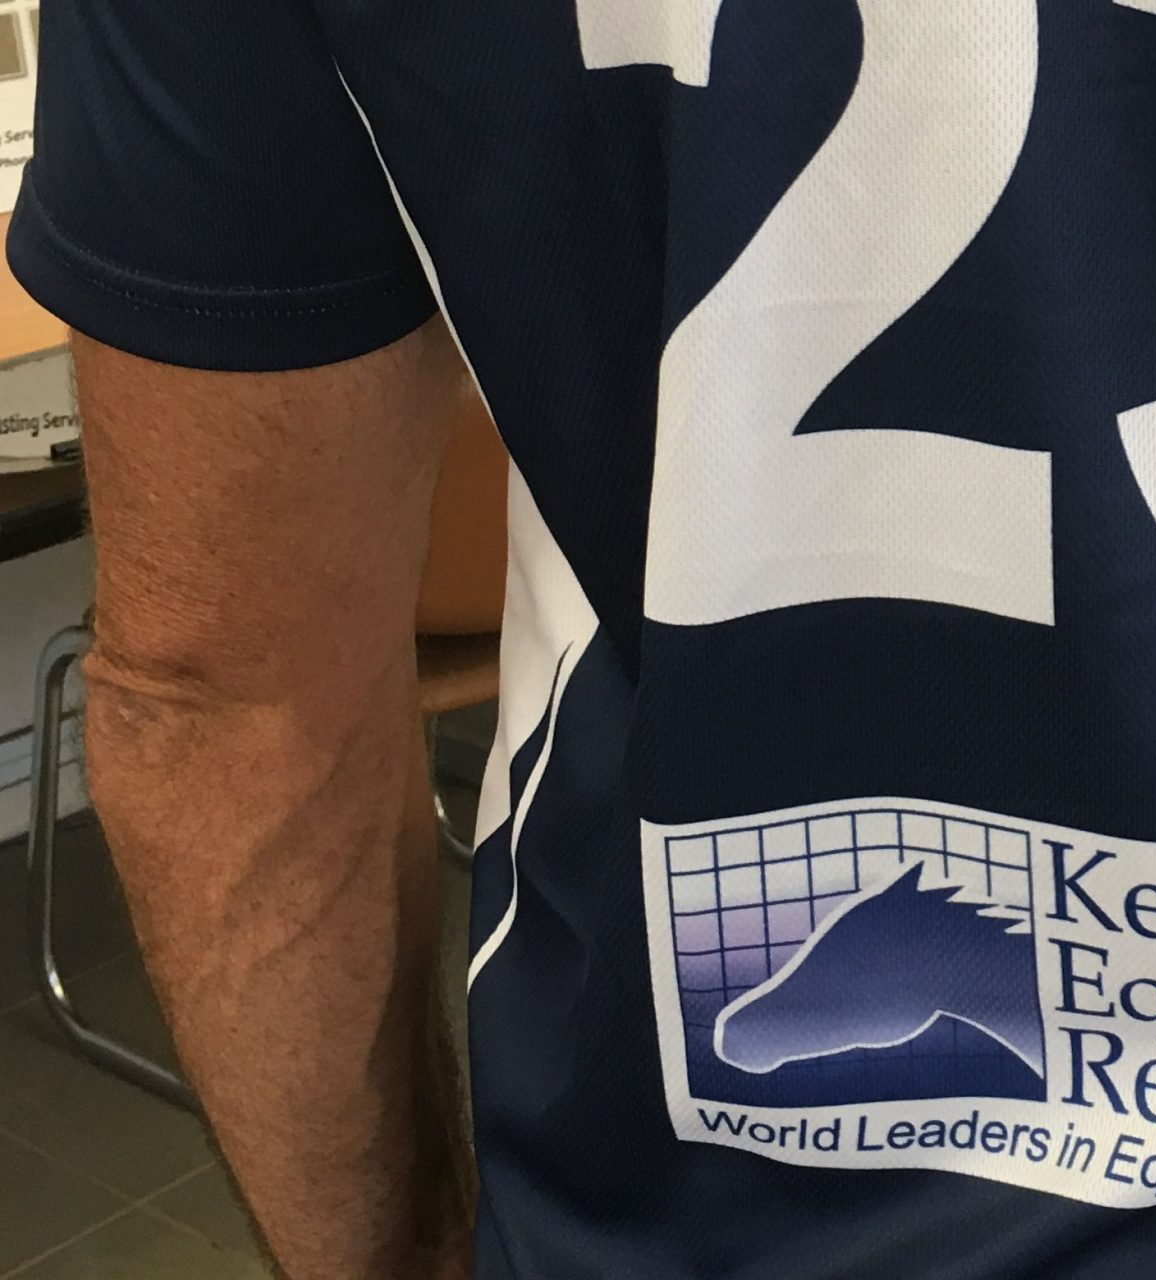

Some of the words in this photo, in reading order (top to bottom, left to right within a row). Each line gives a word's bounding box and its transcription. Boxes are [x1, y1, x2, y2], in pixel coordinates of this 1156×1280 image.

[697, 1108, 841, 1152] World
[856, 1110, 1051, 1163] Leaders
[1055, 1122, 1096, 1173] in
